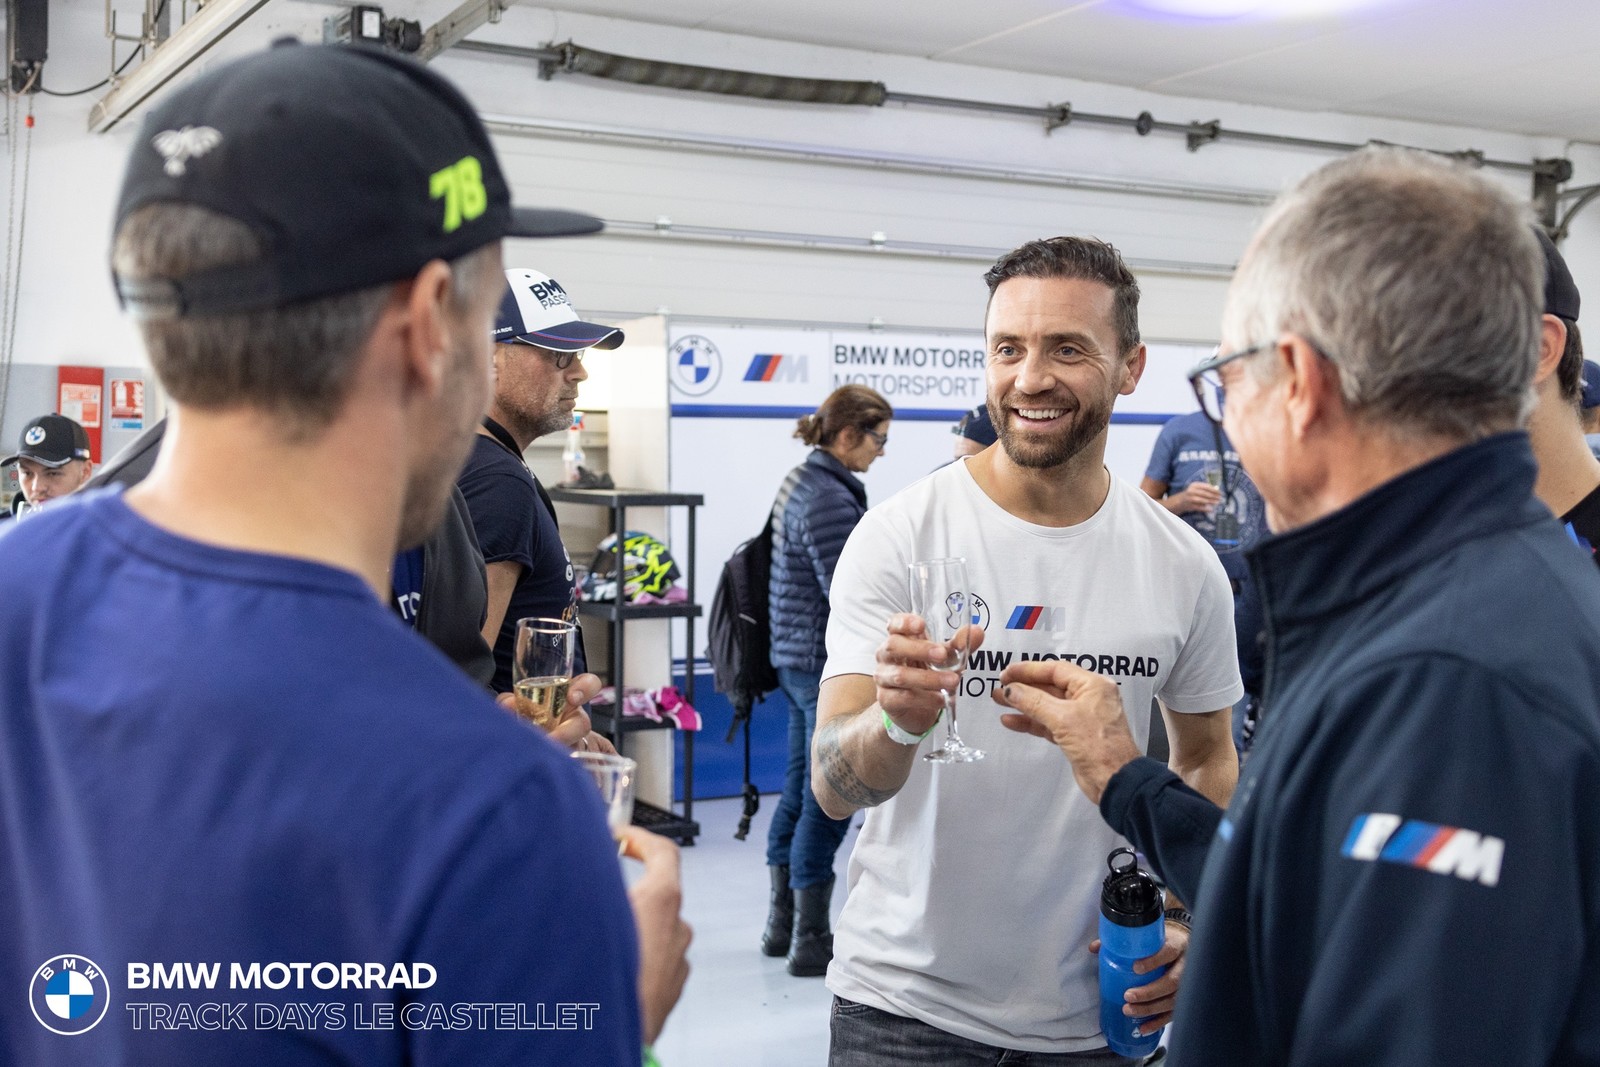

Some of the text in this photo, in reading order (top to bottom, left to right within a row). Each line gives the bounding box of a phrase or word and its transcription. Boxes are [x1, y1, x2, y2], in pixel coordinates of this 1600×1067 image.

[429, 156, 488, 233] 78
[529, 279, 567, 301] BM
[540, 294, 572, 310] PASS
[834, 345, 985, 369] BMW MOTORR
[834, 373, 981, 397] MOTORSPORT
[966, 650, 1012, 672] MW
